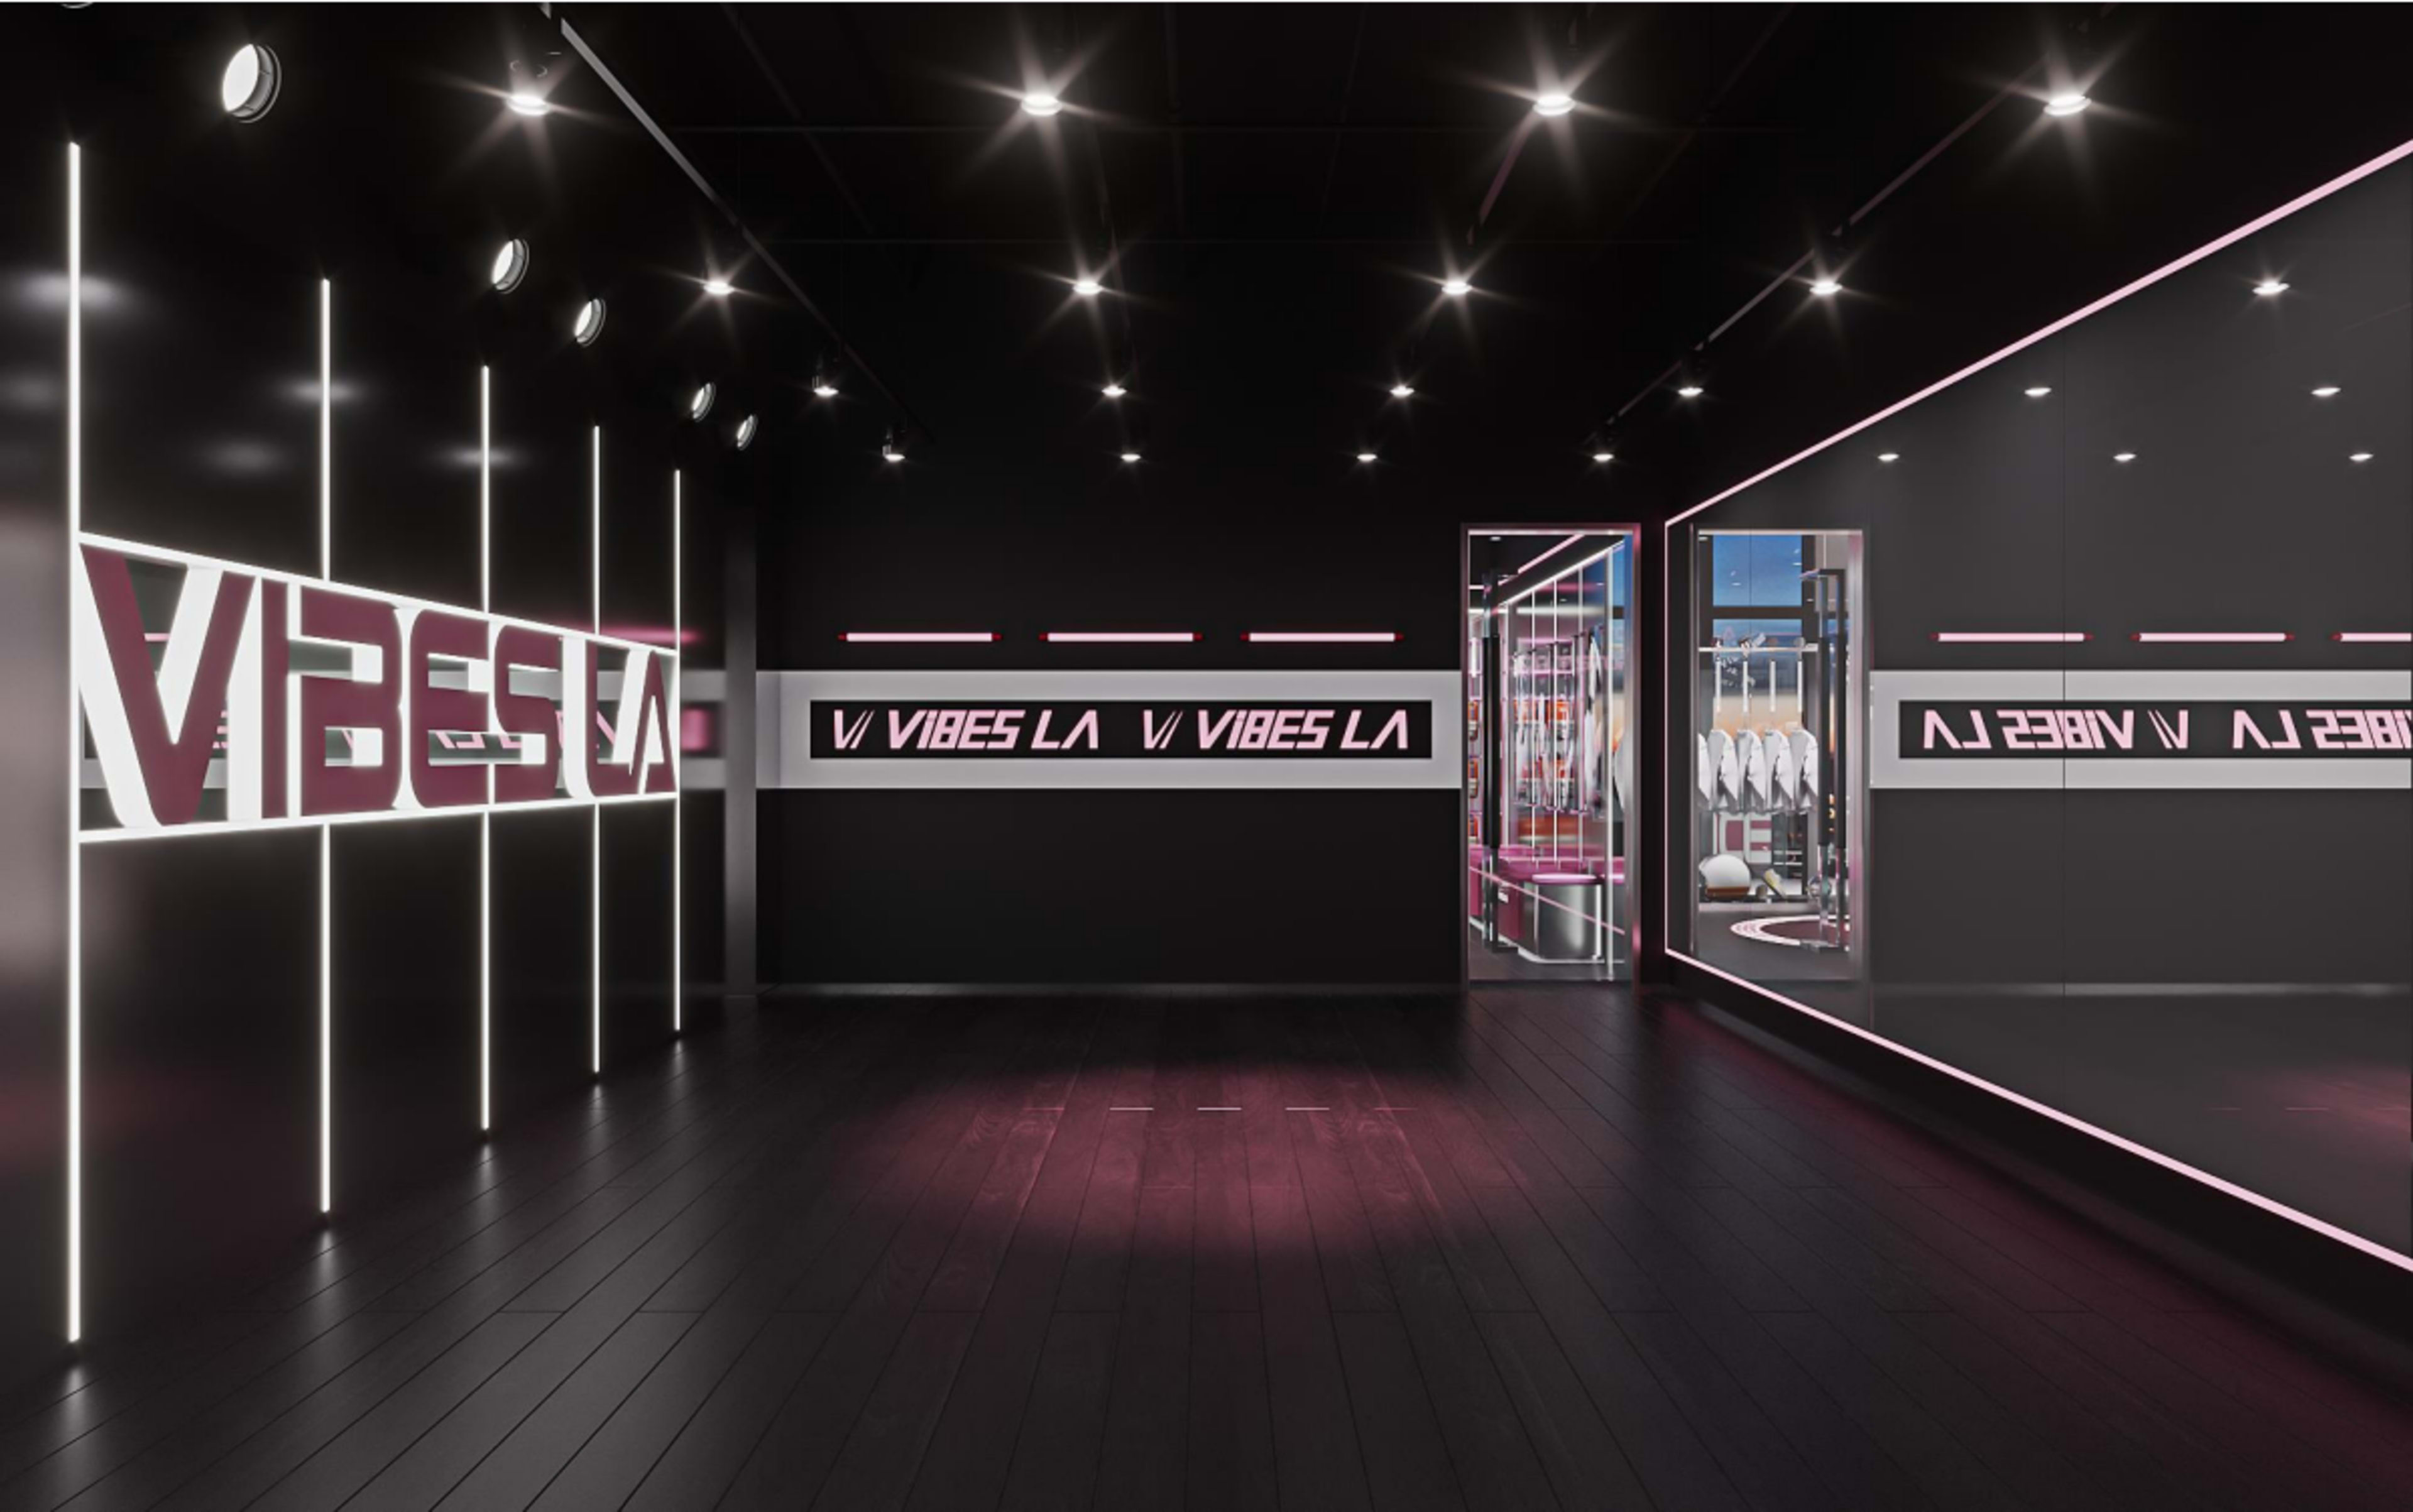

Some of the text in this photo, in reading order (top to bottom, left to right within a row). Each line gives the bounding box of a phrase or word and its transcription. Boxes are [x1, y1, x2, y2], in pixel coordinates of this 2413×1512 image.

[79, 544, 677, 826] VIBES LA
[1031, 709, 1098, 749] LA
[1340, 709, 1408, 749] LA
